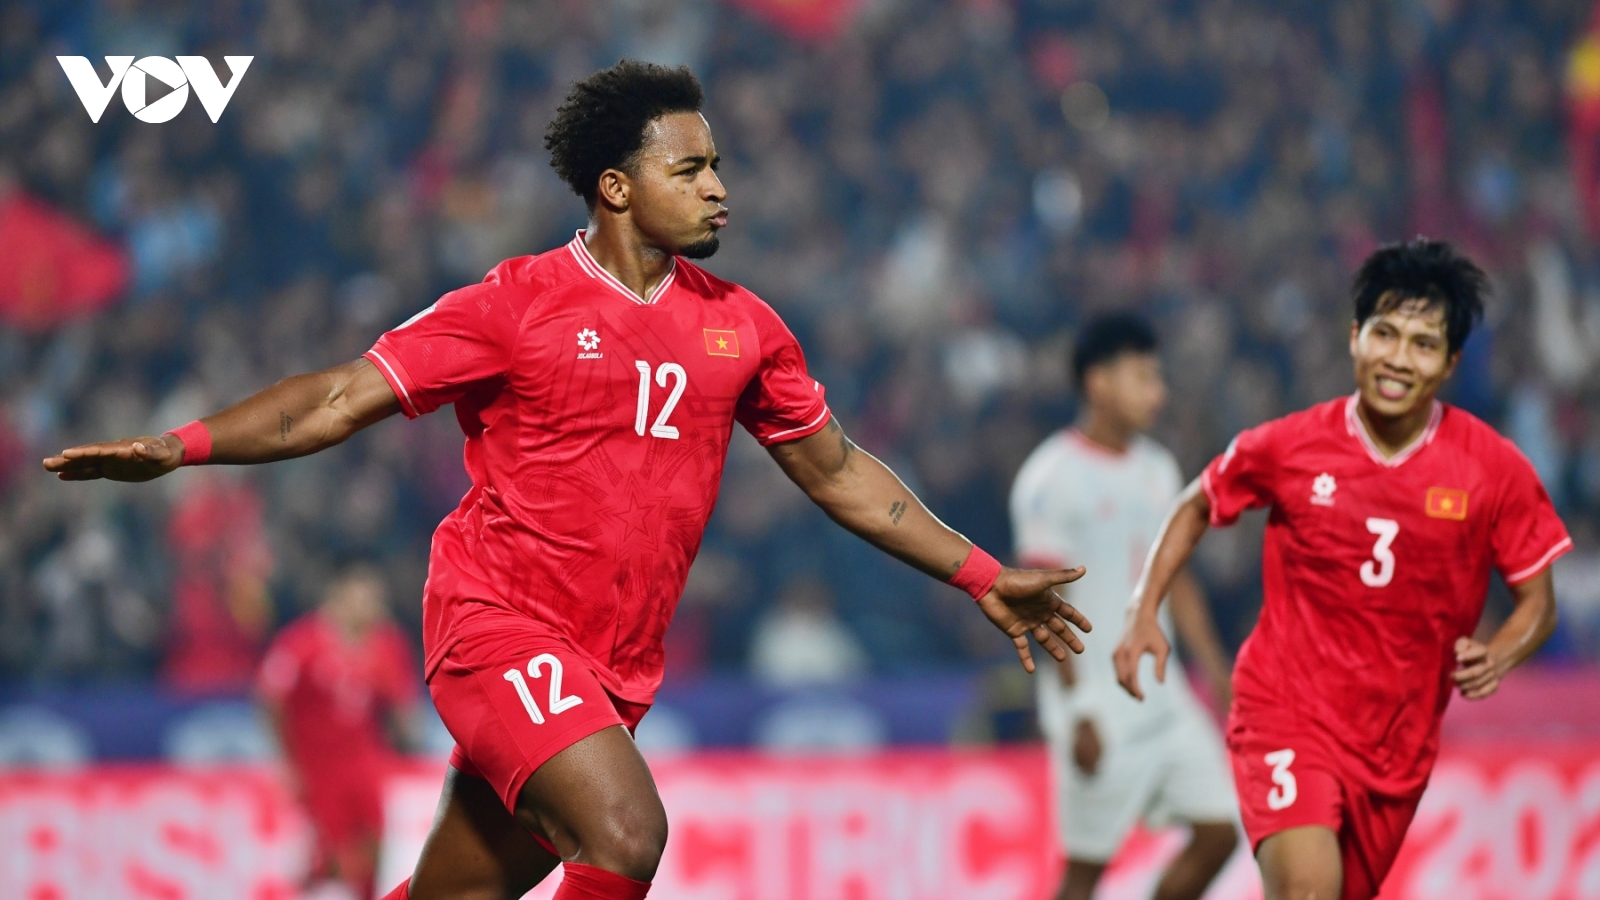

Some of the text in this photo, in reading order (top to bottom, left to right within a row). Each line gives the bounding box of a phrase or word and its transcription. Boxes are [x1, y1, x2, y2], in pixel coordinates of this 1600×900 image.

[634, 359, 687, 440] 12
[1359, 516, 1399, 588] 3
[503, 653, 583, 725] 12
[1264, 748, 1297, 811] 3
